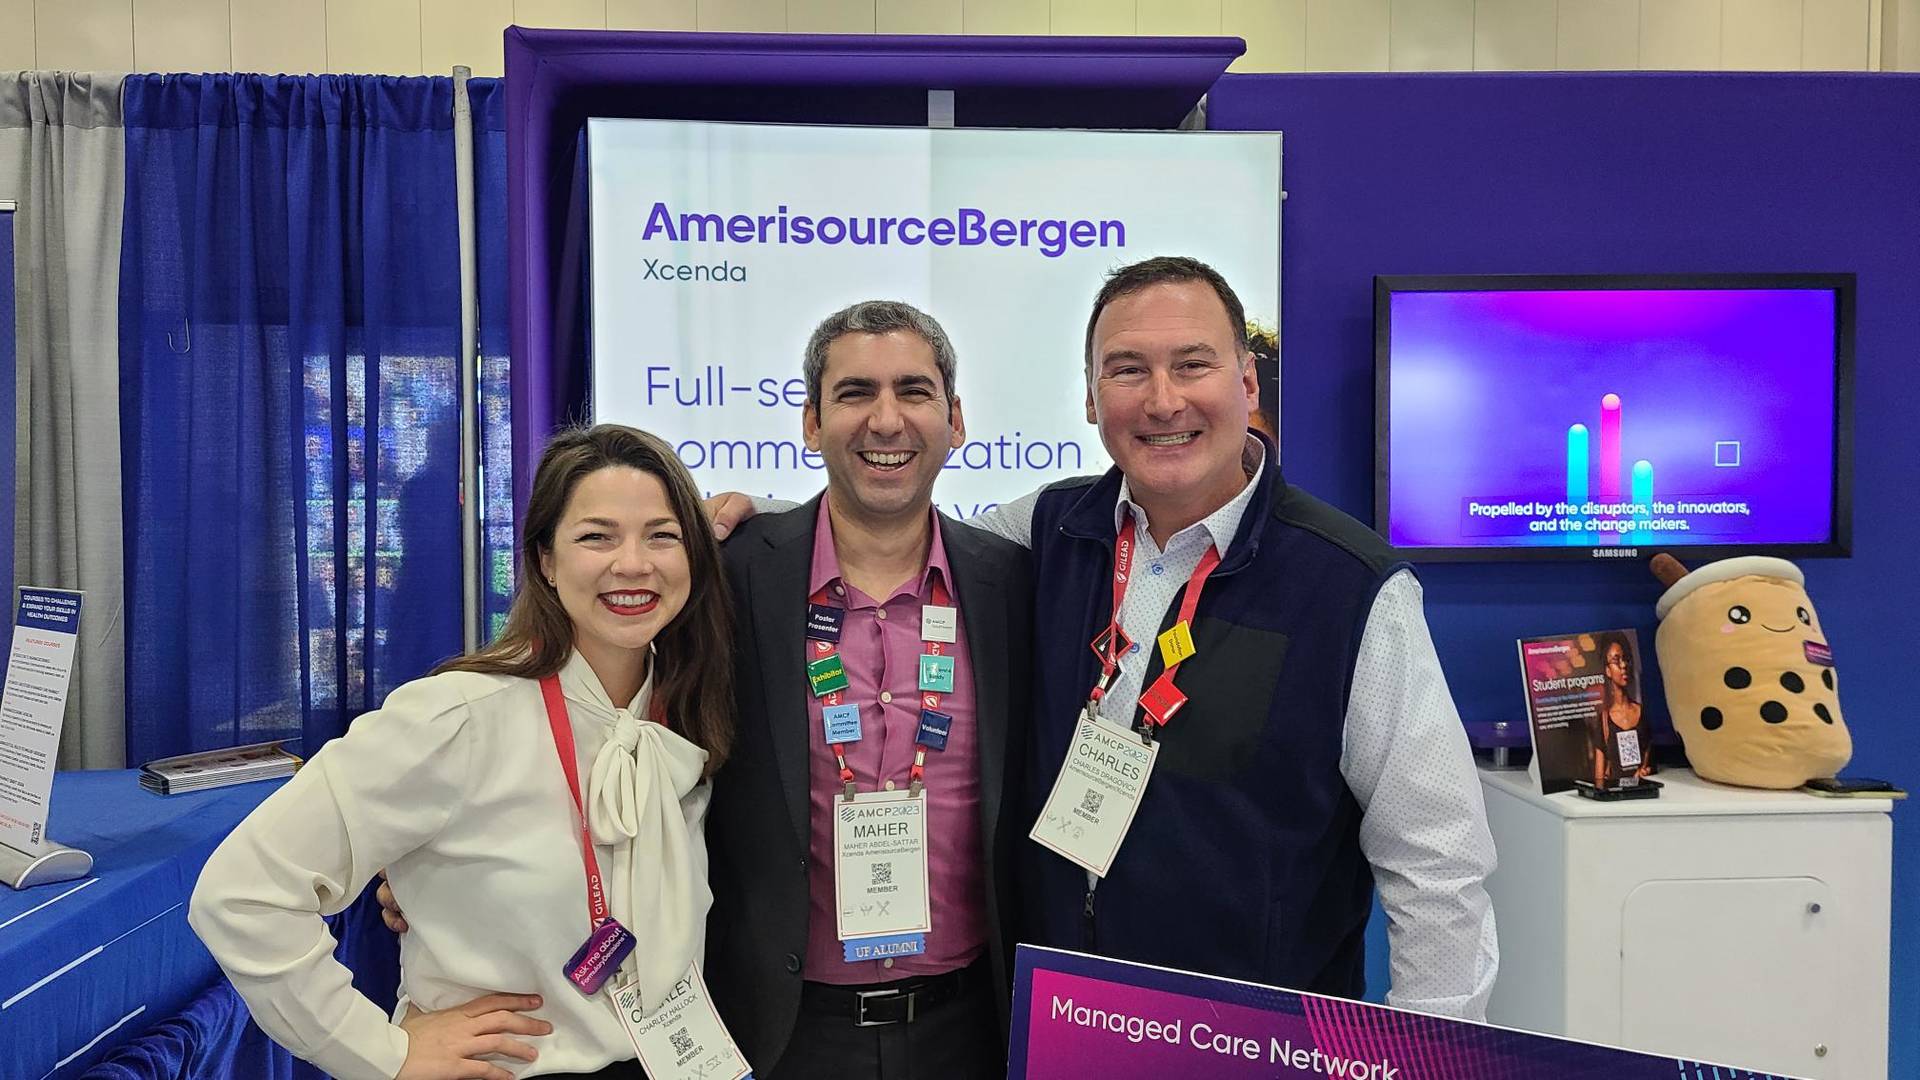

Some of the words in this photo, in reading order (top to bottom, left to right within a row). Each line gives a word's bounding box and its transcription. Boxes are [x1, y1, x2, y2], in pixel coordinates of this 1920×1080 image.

[642, 203, 1126, 258] AmerisourceBergen
[643, 259, 747, 283] Xcenda
[647, 366, 807, 407] Full-se
[1469, 502, 1533, 518] Propelled
[1536, 502, 1552, 518] by
[1555, 502, 1578, 515] the
[1580, 501, 1649, 517] disruptors,
[1652, 501, 1674, 514] the
[1677, 500, 1750, 515] innovators,
[1529, 518, 1557, 531] and
[1559, 518, 1582, 531] the
[1584, 518, 1636, 533] change
[1639, 517, 1690, 531] makers.
[1119, 540, 1129, 571] GILEAD
[1592, 548, 1638, 558] SAMSUNG
[814, 613, 836, 623] Poster
[808, 622, 839, 634] Presenter
[812, 668, 843, 685] Exhibitor
[1532, 678, 1567, 692] Student
[1567, 674, 1605, 690] programs
[921, 723, 948, 737] Volunteer
[1072, 758, 1101, 776] CHARLES
[1079, 743, 1140, 781] CHARLES
[1073, 807, 1101, 825] MEMBER
[854, 822, 909, 838] MAHER
[844, 840, 868, 850] MAHER
[592, 874, 604, 915] GILEAD
[867, 885, 898, 894] MEMBER
[574, 963, 590, 982] Ask
[587, 950, 601, 965] me
[600, 927, 623, 954] about
[855, 946, 872, 958] UF
[873, 941, 918, 956] ALUMNI
[639, 1010, 668, 1035] CHARLEY
[664, 992, 699, 1020] HALLOCK
[1051, 995, 1182, 1045] Managed
[1189, 1023, 1261, 1060] Care
[1270, 1039, 1399, 1080] Network
[676, 1045, 705, 1067] MEMBER
